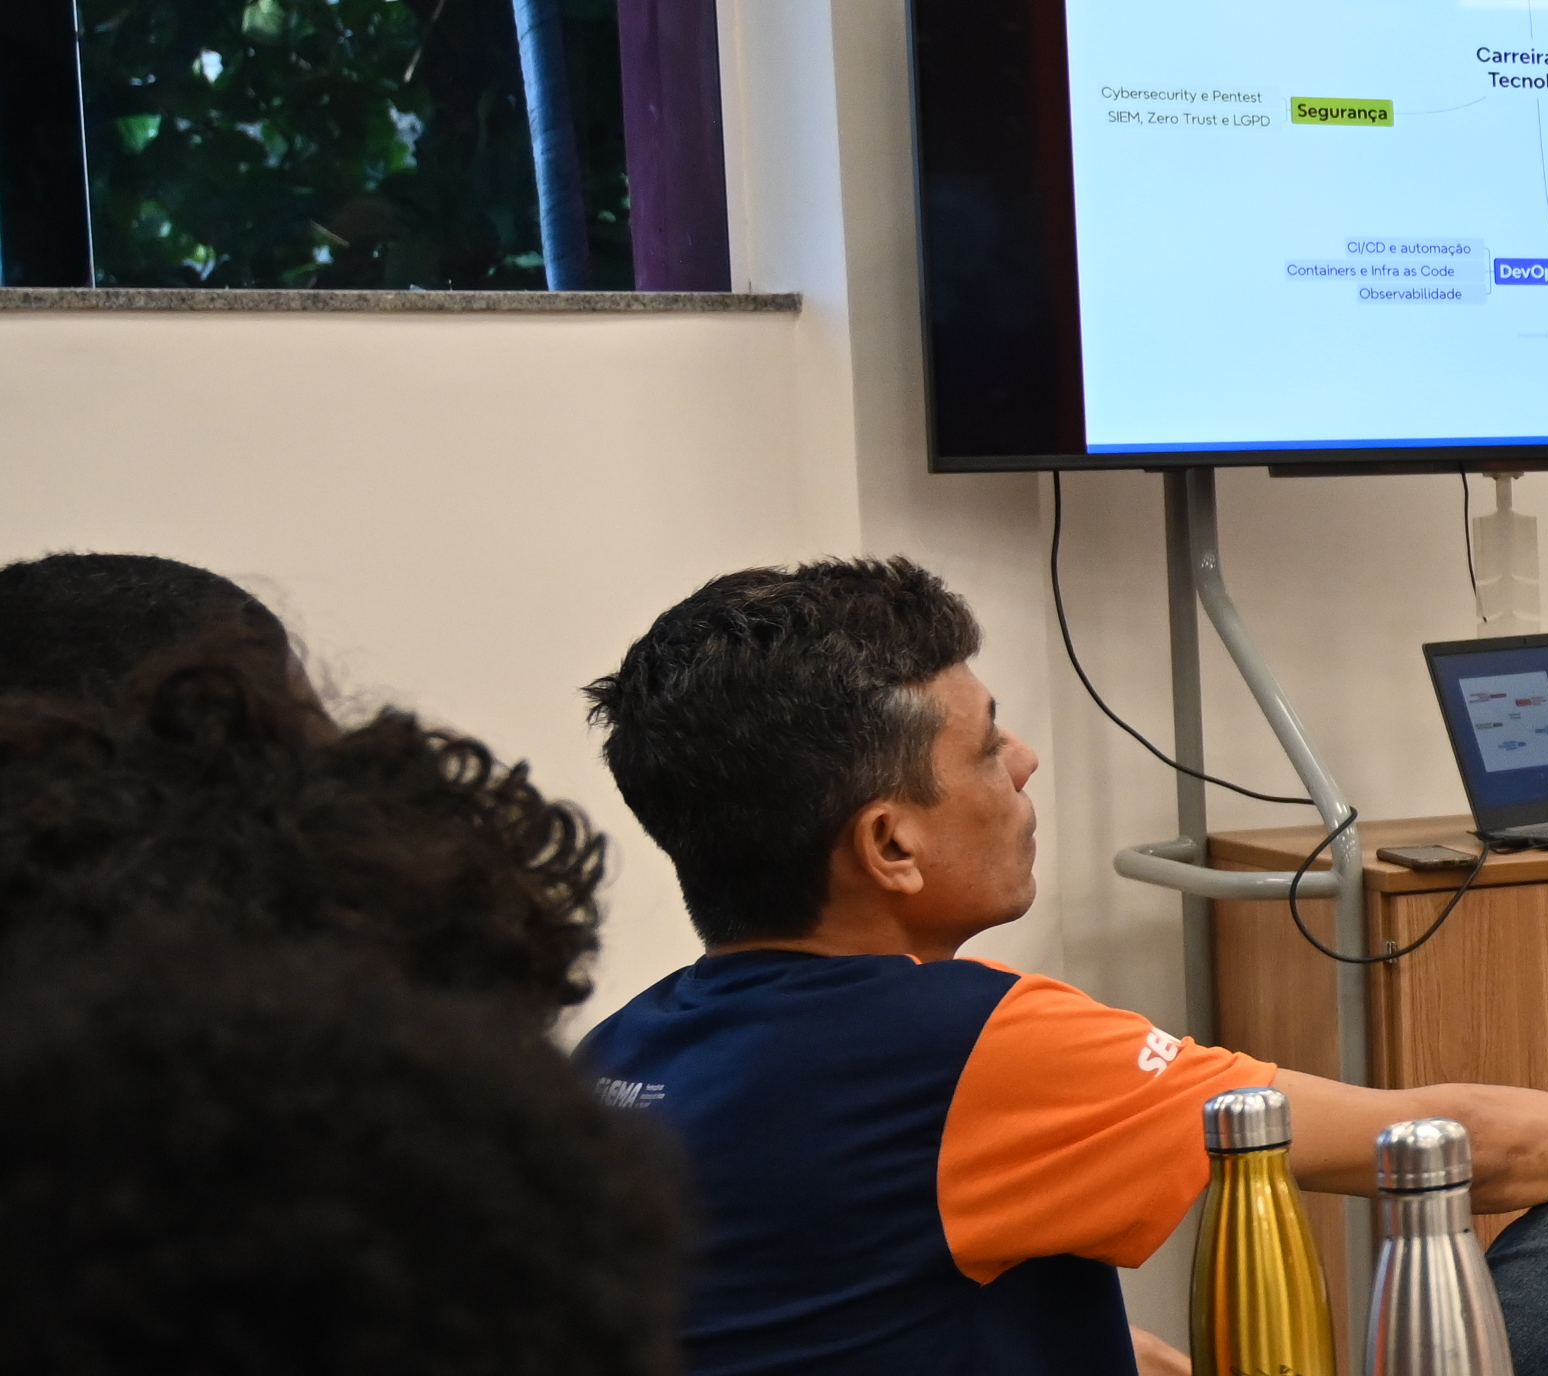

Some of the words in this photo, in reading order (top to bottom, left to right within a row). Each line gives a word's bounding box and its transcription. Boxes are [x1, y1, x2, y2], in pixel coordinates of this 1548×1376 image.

[1101, 85, 1197, 105] Cybersecurity
[1200, 92, 1209, 102] e
[1212, 89, 1262, 103] Pentest
[1107, 110, 1144, 126] SIEM,
[1147, 111, 1179, 125] Zero
[1183, 112, 1218, 126] Trust
[1221, 116, 1230, 126] e
[1233, 113, 1271, 127] LGPD
[1297, 103, 1388, 124] Segurança
[1346, 240, 1386, 256] CI/CD
[1389, 245, 1398, 254] e
[1400, 242, 1471, 258] automação
[1286, 264, 1356, 278] Containers
[1360, 268, 1368, 277] e
[1371, 264, 1400, 278] Infra
[1403, 268, 1418, 278] as
[1420, 264, 1455, 278] Code
[1359, 286, 1462, 301] Observabilidade
